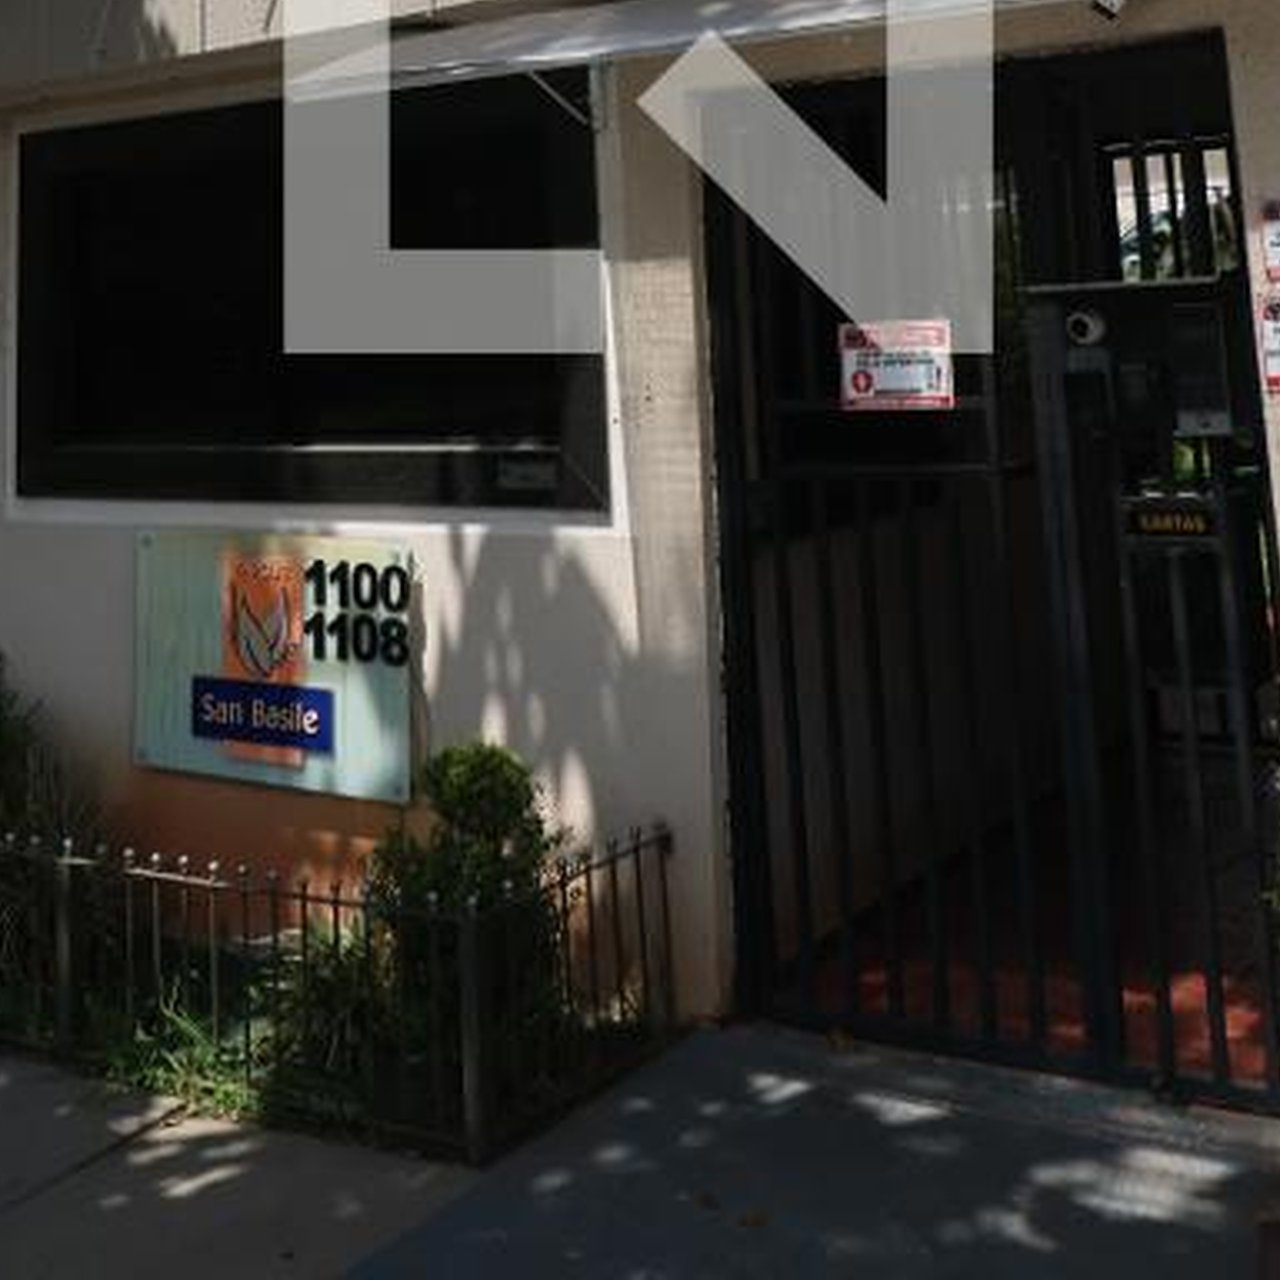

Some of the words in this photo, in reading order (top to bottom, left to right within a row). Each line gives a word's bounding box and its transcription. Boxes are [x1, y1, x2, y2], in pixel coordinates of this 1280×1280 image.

[305, 559, 410, 612] 1100
[304, 612, 410, 667] 1108
[201, 693, 243, 725] San
[253, 699, 320, 735] Basile
